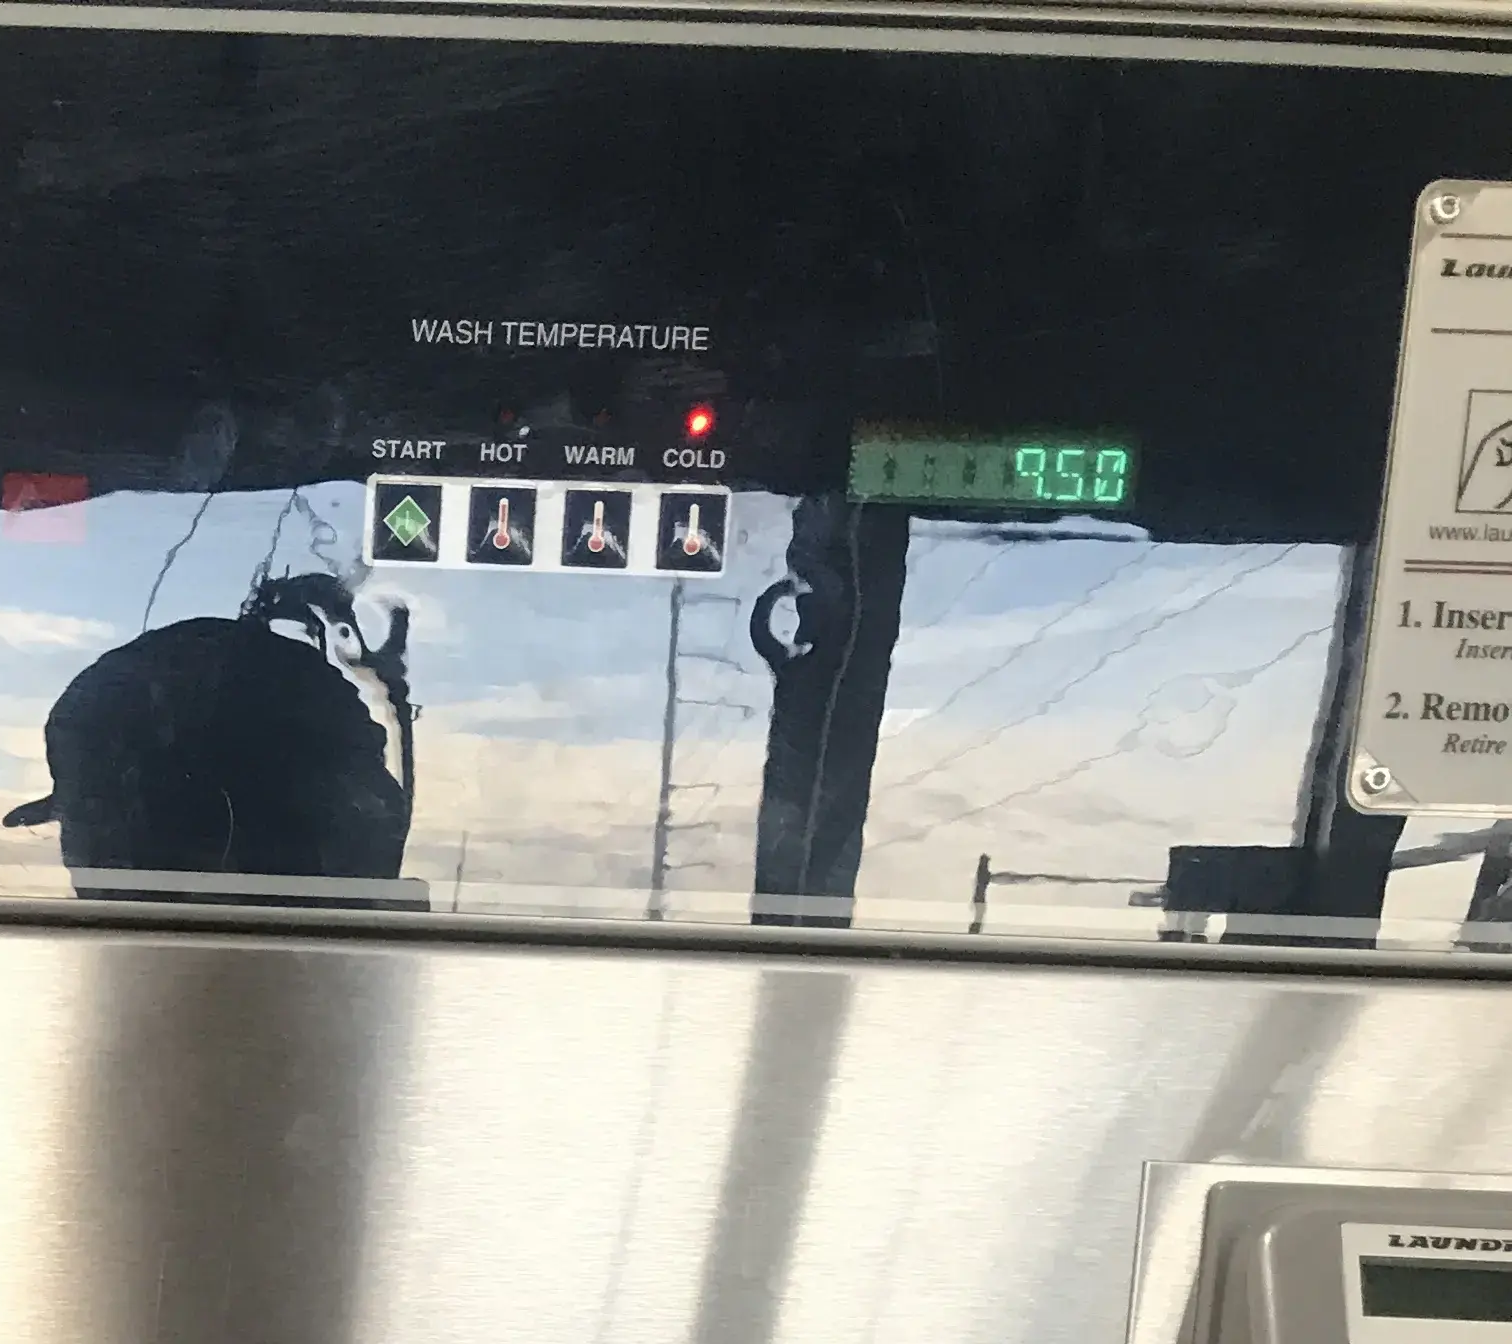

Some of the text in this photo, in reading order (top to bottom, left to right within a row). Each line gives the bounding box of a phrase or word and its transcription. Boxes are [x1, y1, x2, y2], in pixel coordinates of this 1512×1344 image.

[411, 318, 710, 352] WASH TEMPERATURE
[372, 438, 446, 461] START
[480, 442, 527, 463] HOT
[564, 445, 635, 467] WARM
[662, 447, 726, 470] COLD
[1397, 599, 1422, 628] 1.
[1455, 638, 1512, 660] Inser
[1383, 691, 1410, 719] 2.
[1442, 732, 1508, 755] Retire
